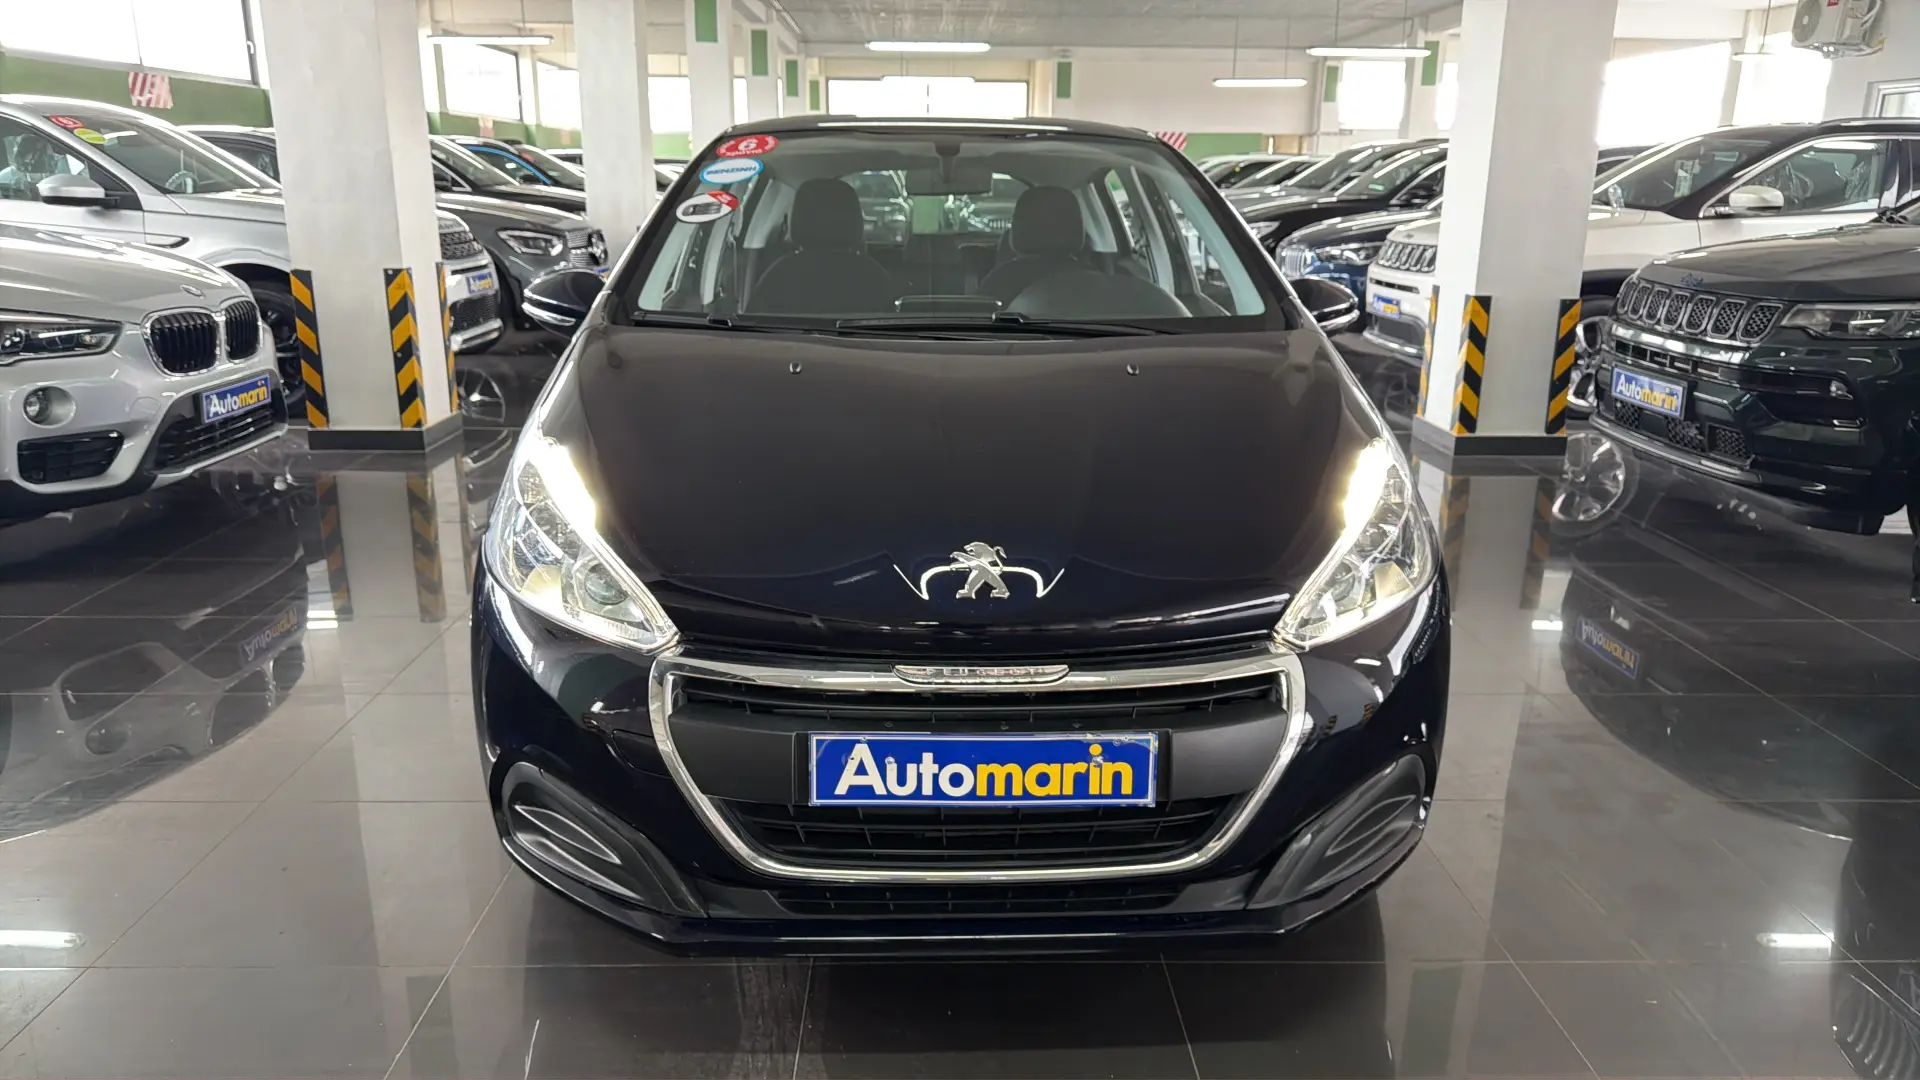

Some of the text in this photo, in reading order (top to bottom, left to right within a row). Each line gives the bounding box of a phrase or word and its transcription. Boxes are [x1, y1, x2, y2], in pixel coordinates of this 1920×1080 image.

[738, 138, 758, 152] 6
[209, 380, 268, 418] Automarin
[1616, 373, 1678, 411] Automarin
[834, 743, 1133, 796] Automarin
